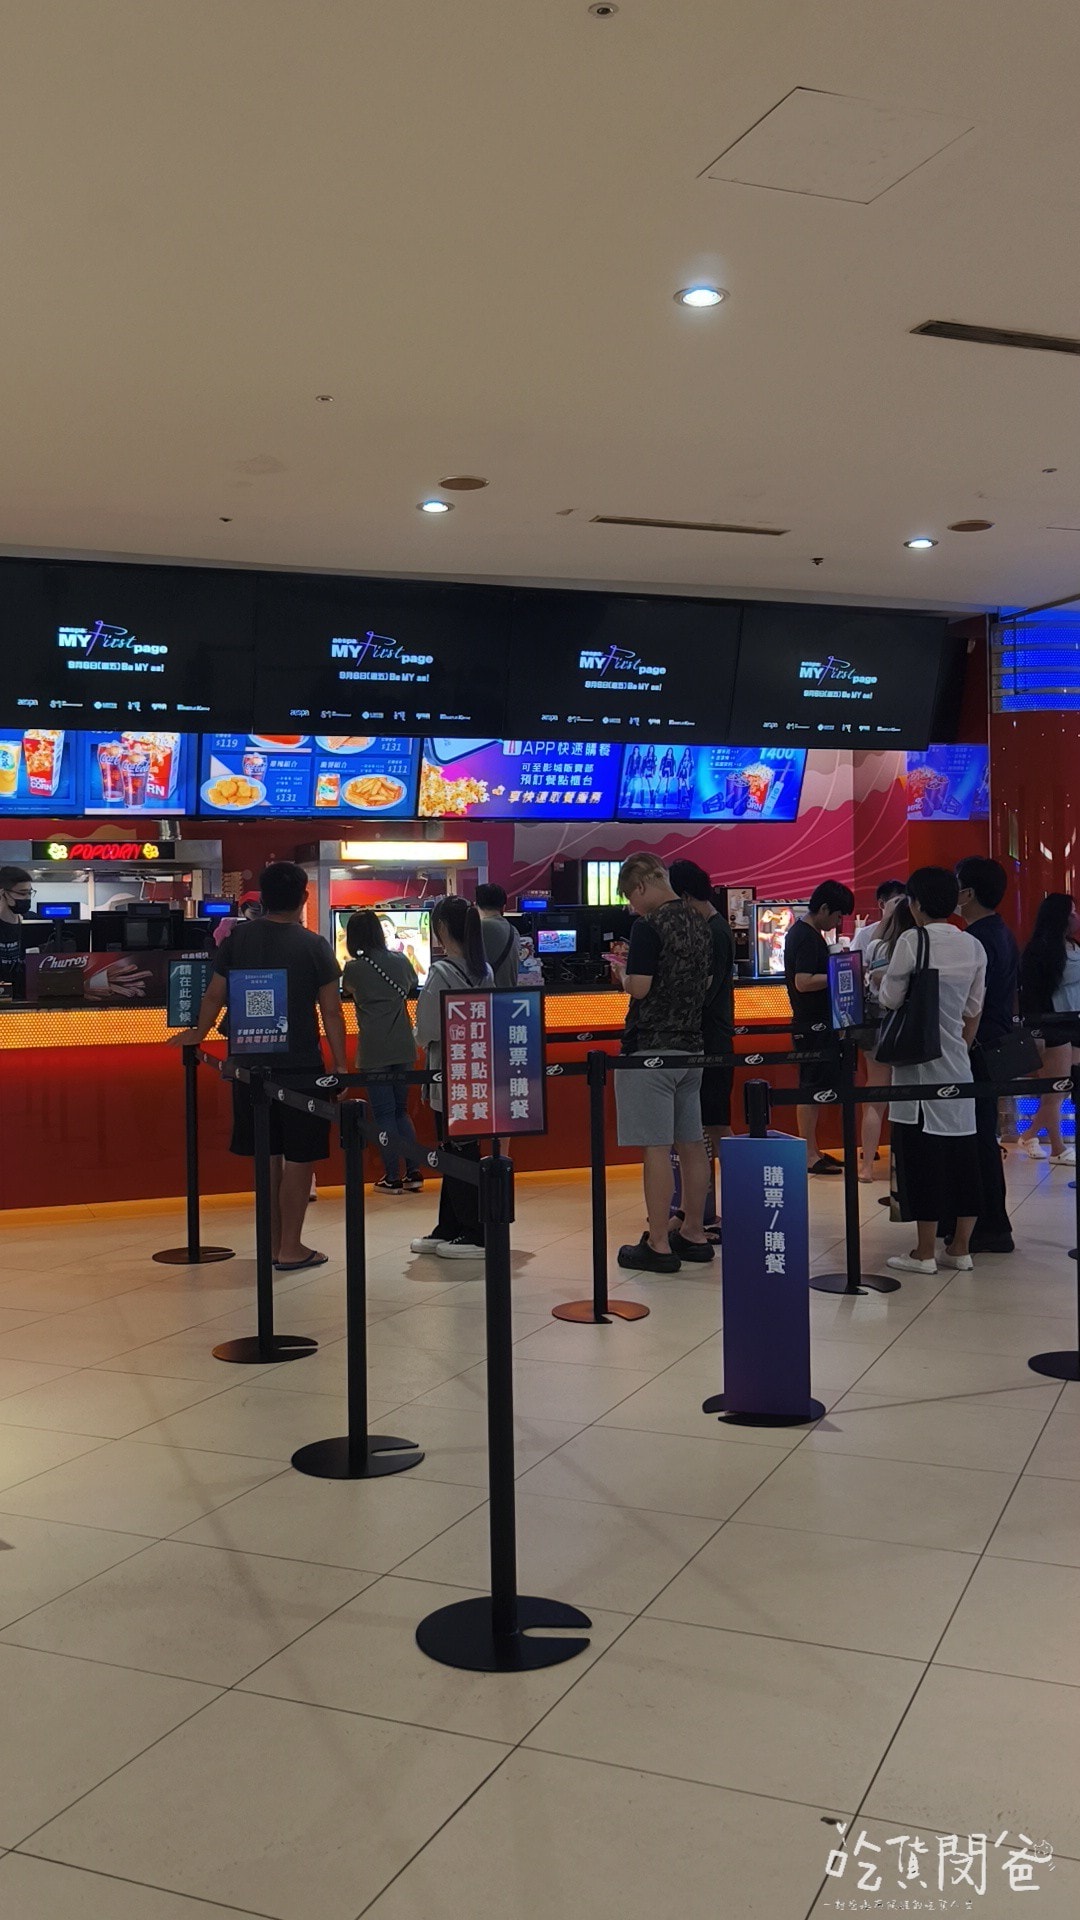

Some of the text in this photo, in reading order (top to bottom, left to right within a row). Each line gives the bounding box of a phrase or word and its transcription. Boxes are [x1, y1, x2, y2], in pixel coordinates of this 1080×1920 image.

[58, 619, 168, 657] MY First page
[331, 630, 434, 667] MY First page
[134, 662, 149, 672] MY
[579, 644, 667, 677] MY First page
[799, 655, 878, 686] MY First page
[401, 673, 414, 682] MY
[638, 682, 649, 690] MY
[851, 691, 862, 699] MY
[216, 739, 238, 748] $119
[381, 743, 401, 752] $131
[522, 741, 611, 757] APP 快速購餐
[388, 765, 407, 774] $111
[521, 763, 594, 773] 可至影城販賣部
[520, 773, 593, 786] 預訂餐點櫃台
[31, 782, 52, 791] CORN
[276, 794, 297, 802] $131
[69, 843, 142, 860] POPCORN
[39, 955, 89, 969] Churros
[179, 964, 192, 1023] 請在此等候
[470, 1001, 488, 1120] 預訂餐點取餐
[450, 1043, 468, 1120] 套票換餐
